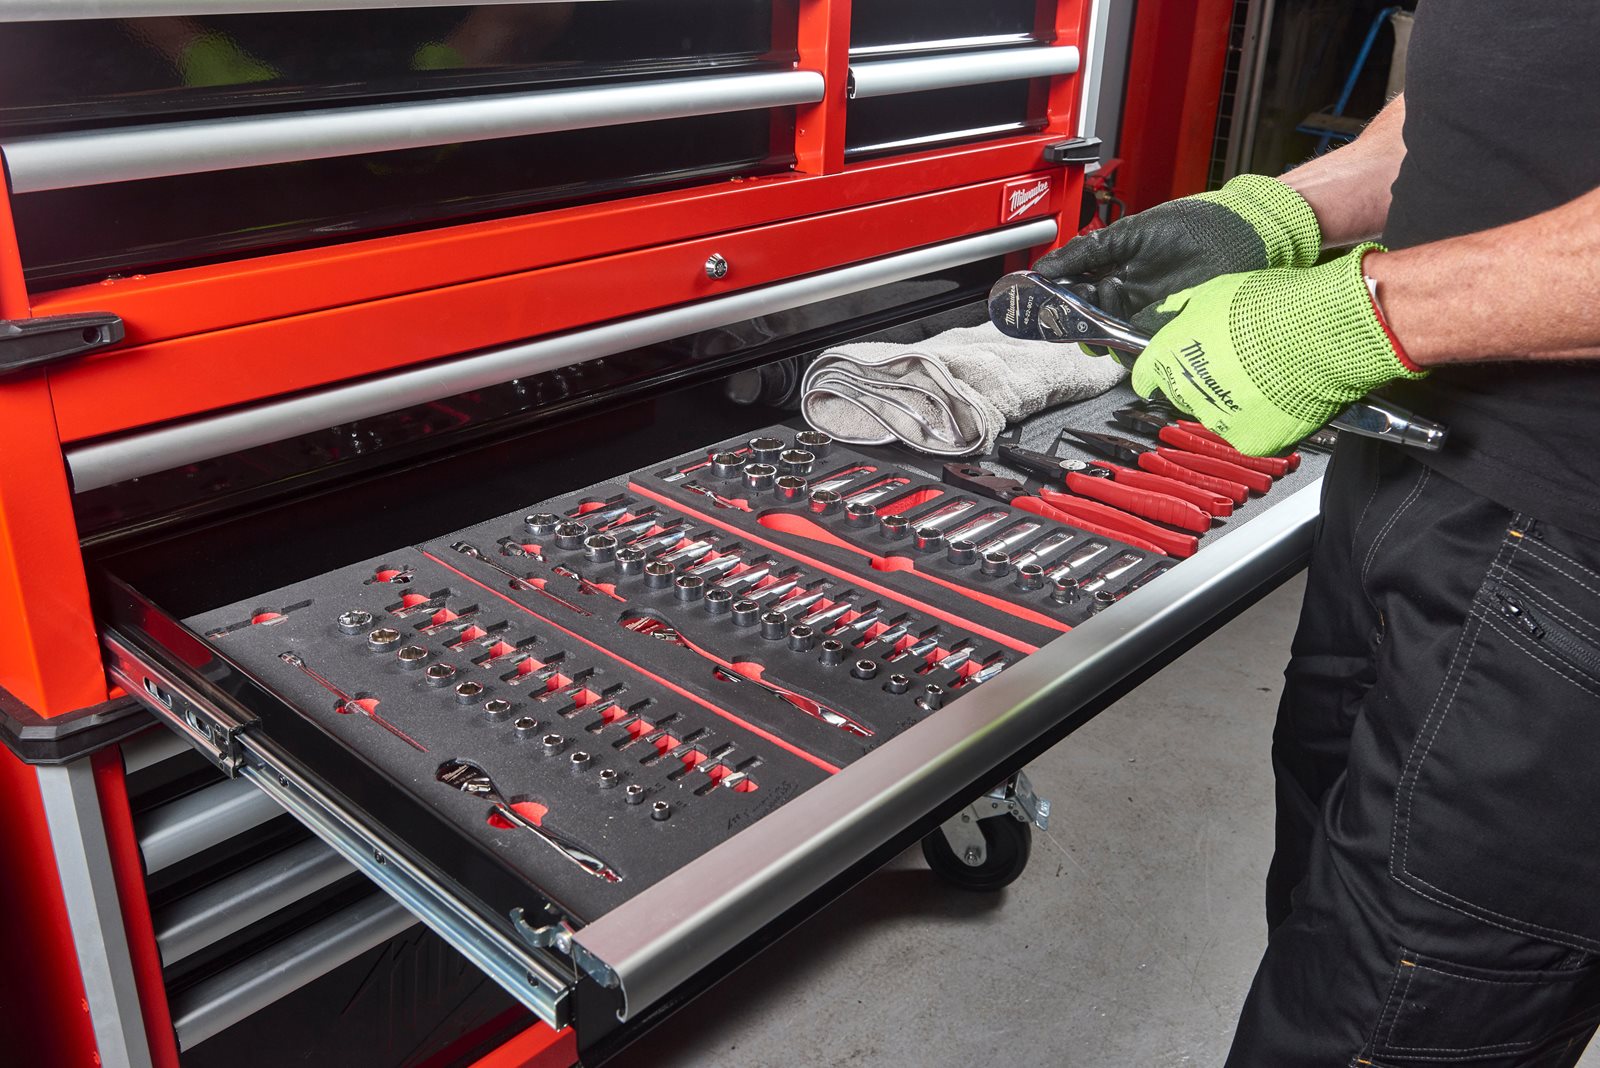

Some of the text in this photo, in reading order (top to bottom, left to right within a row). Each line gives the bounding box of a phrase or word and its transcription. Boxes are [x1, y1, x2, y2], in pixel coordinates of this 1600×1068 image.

[1009, 181, 1048, 212] Milwaukee
[1005, 285, 1016, 325] Milwaukee
[1181, 339, 1240, 413] Milwaukee
